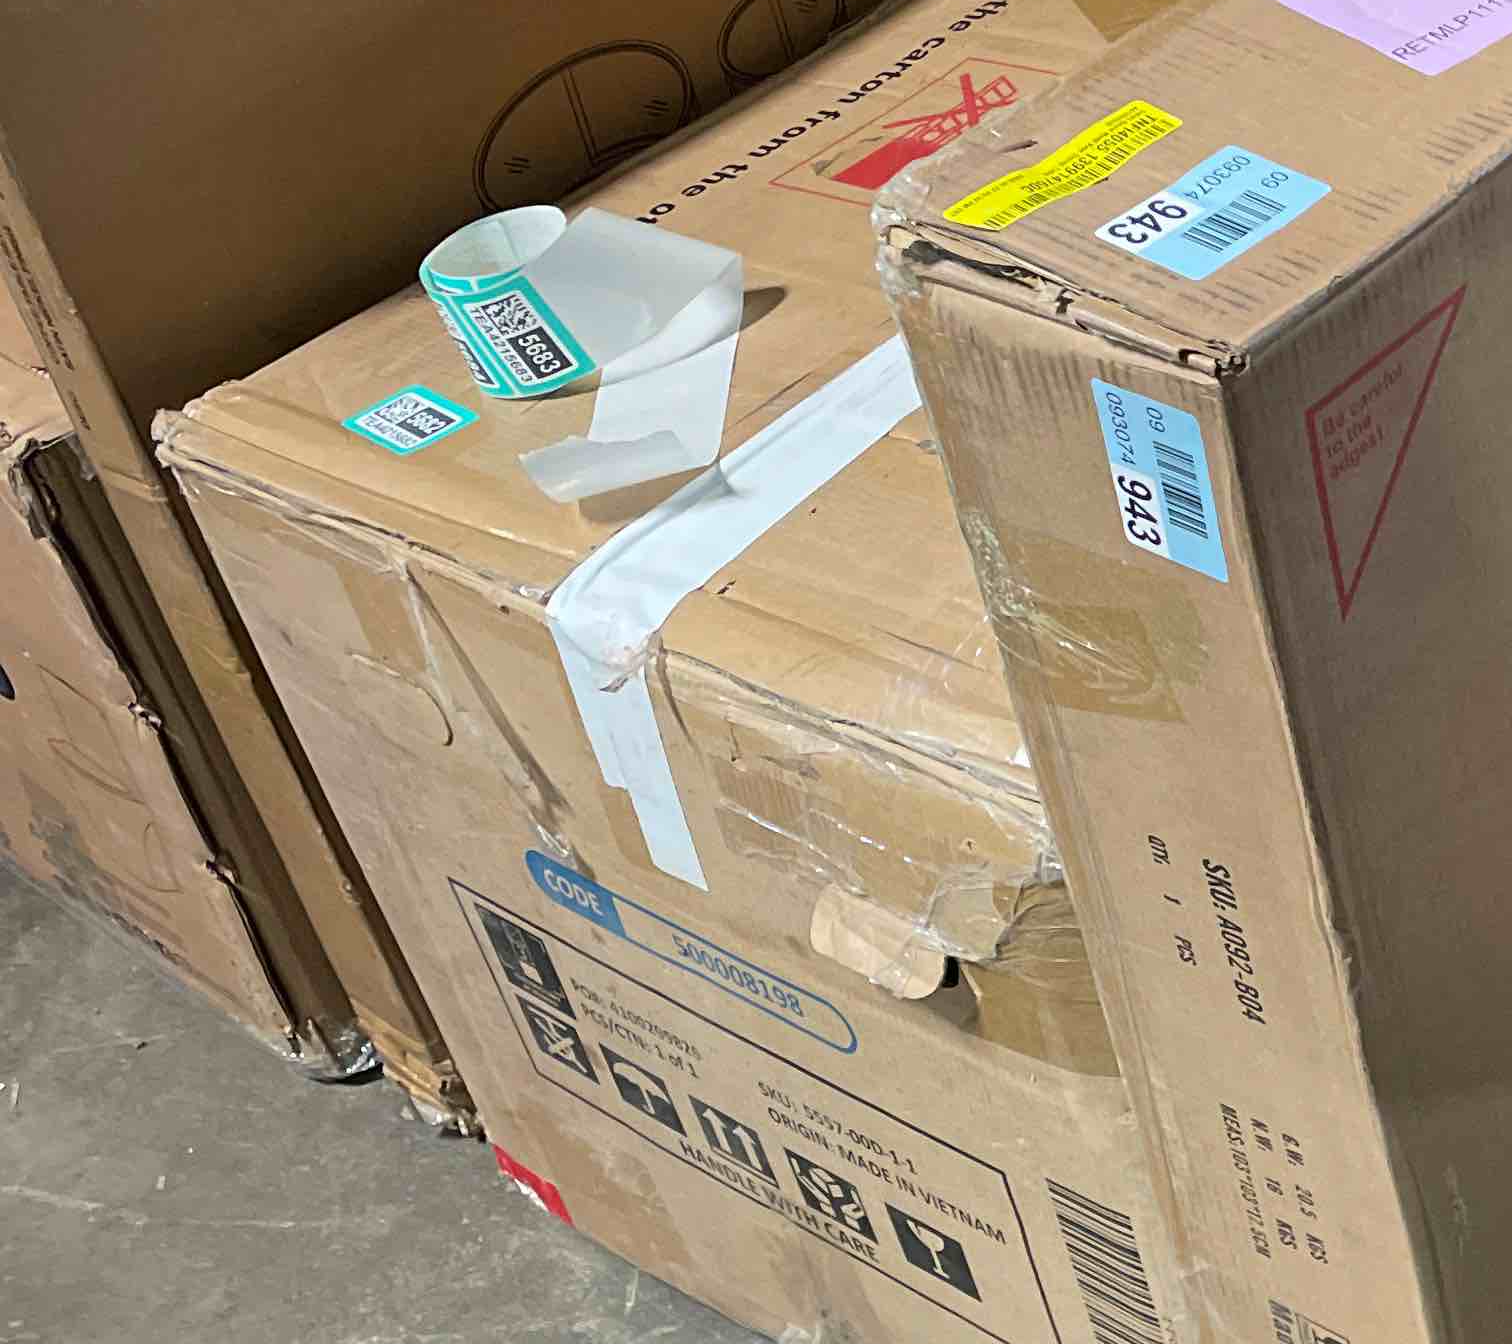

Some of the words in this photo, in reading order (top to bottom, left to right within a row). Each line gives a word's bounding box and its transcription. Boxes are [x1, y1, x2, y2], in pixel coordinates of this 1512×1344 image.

[950, 0, 1010, 32] the
[837, 36, 946, 105] carton
[748, 108, 841, 158] from
[681, 163, 750, 198] the
[1182, 154, 1251, 201] 093074
[1260, 170, 1289, 189] 09
[1108, 198, 1189, 245] 943
[518, 333, 561, 374] 5683
[406, 411, 452, 435] 5682
[1105, 391, 1137, 466] 093074
[1146, 407, 1166, 433] 09
[1117, 474, 1163, 547] 943
[542, 868, 607, 919] CODE
[1202, 858, 1239, 911] SKU:
[1163, 893, 1182, 906] 1
[1174, 934, 1197, 967] PCS
[671, 931, 806, 1018] 500008198
[1216, 914, 1267, 1025] A092-B04
[686, 1061, 700, 1080] 1
[757, 1080, 797, 1114] SKU:
[767, 1106, 836, 1154] ORIGIN:
[836, 1144, 893, 1186] MADE
[896, 1174, 917, 1199] IN
[917, 1185, 1007, 1246] VIETNAM
[679, 1141, 761, 1197] HANDLE
[764, 1185, 822, 1232] WITH
[825, 1222, 881, 1264] CARE
[1275, 1217, 1298, 1250] KGS
[1305, 1232, 1329, 1265] KGS
